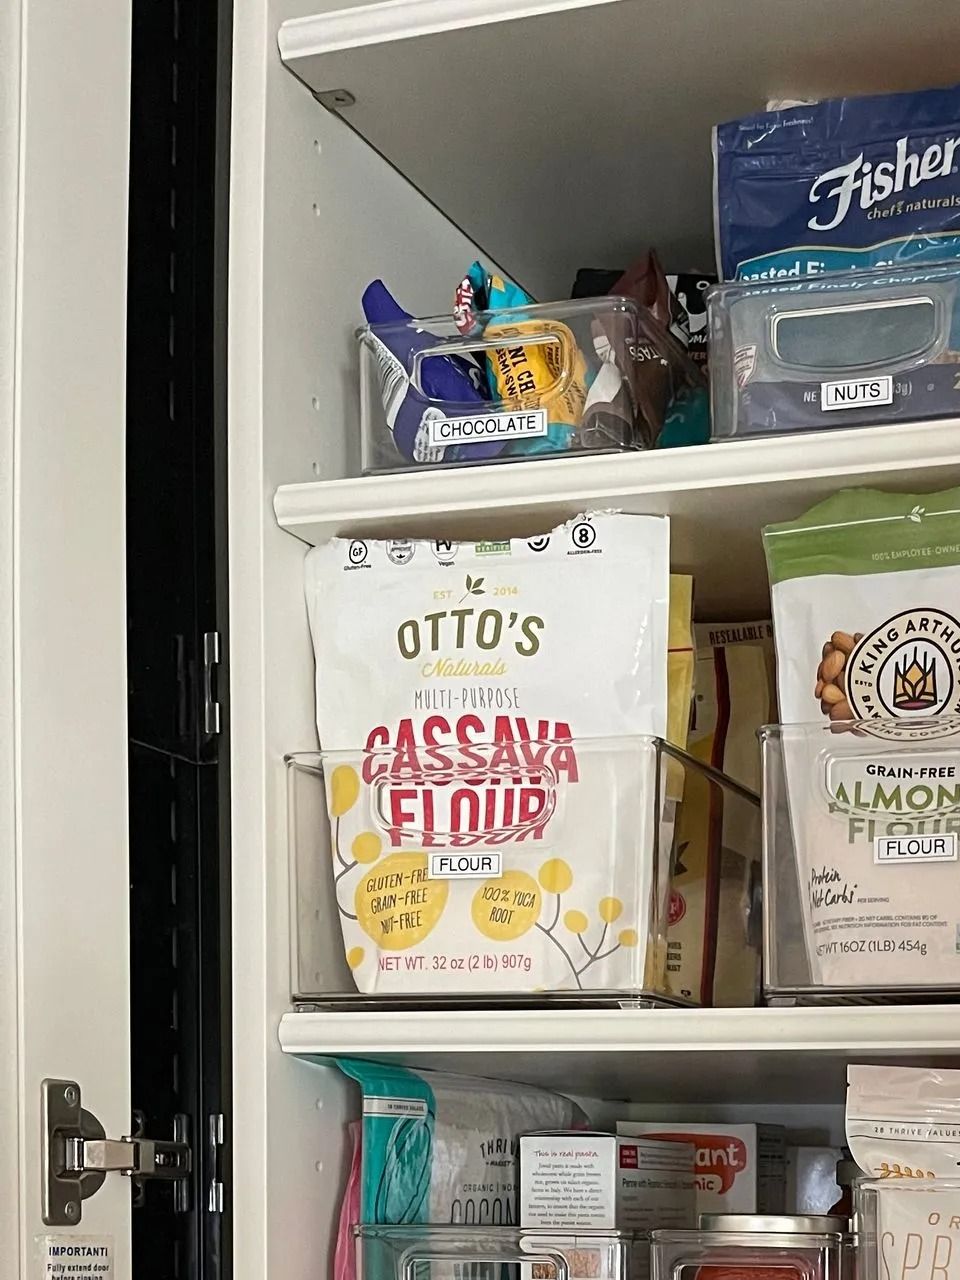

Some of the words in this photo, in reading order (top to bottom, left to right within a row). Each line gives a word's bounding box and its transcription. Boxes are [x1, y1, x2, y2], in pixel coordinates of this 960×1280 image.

[905, 195, 960, 212] naturals
[834, 383, 881, 401] NUTS
[440, 415, 537, 438] CHOCOLATE
[492, 585, 519, 597] 2014
[397, 608, 545, 660] OTTO'S
[708, 624, 764, 645] RESEALABLE
[859, 628, 899, 675] KING
[421, 658, 508, 678] Naturals
[414, 687, 520, 709] MULTI-PURPOSE
[866, 764, 956, 778] GRAIN-FREE
[886, 838, 946, 856] FLOUR
[439, 857, 492, 872] FLOUR
[811, 866, 841, 884] Protein
[370, 888, 428, 915] GRAIN-FREE
[481, 886, 510, 902] 100%
[512, 890, 536, 909] YUCA
[380, 910, 423, 935] NUT-FREE
[488, 907, 515, 924] ROOT
[898, 940, 928, 955] 454g
[377, 954, 402, 972] NET
[431, 955, 447, 970] 32
[449, 959, 464, 970] oz
[467, 955, 481, 973] (2
[482, 954, 499, 973] lb)
[501, 953, 532, 972] 907g
[889, 1128, 922, 1136] THRIVE
[463, 1184, 493, 1192] ORGANIC
[47, 1264, 66, 1273] Fully
[68, 1264, 91, 1272] extend
[93, 1264, 109, 1272] door
